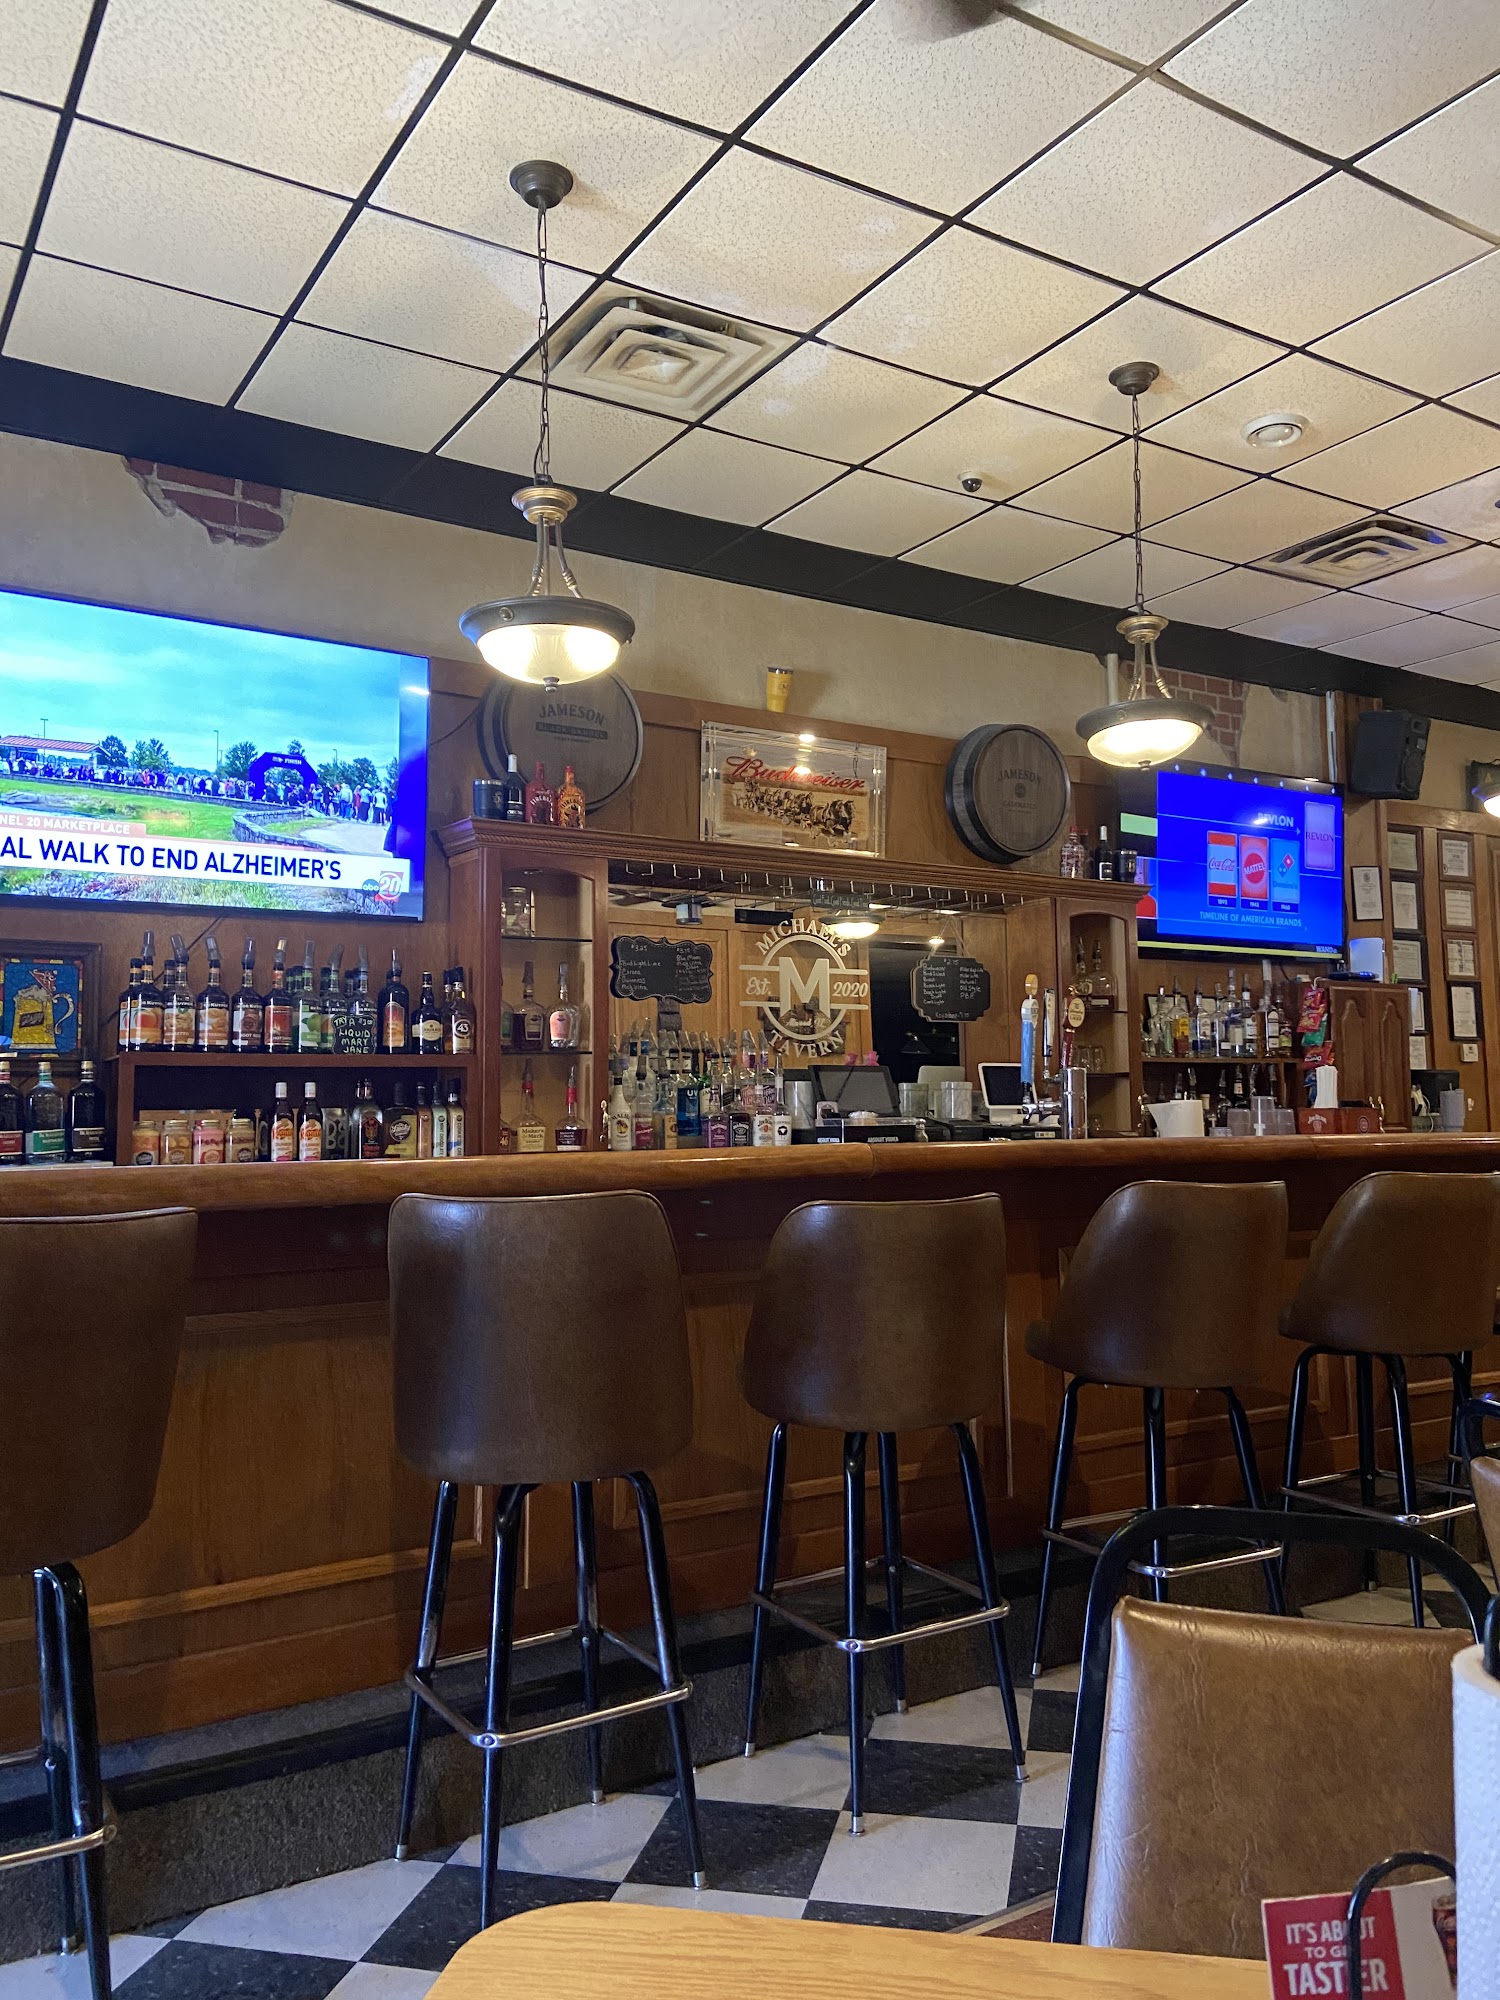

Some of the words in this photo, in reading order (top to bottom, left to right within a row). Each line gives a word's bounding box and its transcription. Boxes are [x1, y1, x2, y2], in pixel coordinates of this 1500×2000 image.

[539, 704, 605, 727] JAMESON
[726, 756, 865, 789] Budweiser
[998, 768, 1042, 785] JAMESON
[26, 816, 41, 828] 20
[43, 818, 131, 835] MARKETPLACE
[1305, 831, 1335, 842] REVLON
[0, 836, 32, 859] AL
[39, 838, 110, 865] WALK
[116, 844, 145, 867] TO
[152, 847, 198, 870] END
[204, 852, 342, 880] ALZHEIMER'S
[1243, 863, 1266, 875] MATTEL
[362, 883, 380, 892] abc
[1200, 911, 1228, 921] TIMELINE
[1230, 914, 1240, 922] OF
[1241, 915, 1275, 925] AMERICAN
[1276, 918, 1302, 927] BRANDS
[755, 918, 851, 957] MICHAEL'S
[745, 976, 771, 996] Est.
[832, 981, 869, 998] 2020
[778, 956, 831, 1019] M
[334, 1016, 347, 1027] TRY
[349, 1018, 356, 1026] A
[457, 1022, 469, 1033] 43
[338, 1028, 371, 1038] LIQUID
[341, 1038, 368, 1046] MARY
[343, 1046, 369, 1054] JANE
[769, 1030, 844, 1059] TAVERN
[686, 1089, 699, 1097] UV
[1286, 1922, 1318, 1945] IT'S
[1321, 1916, 1376, 1942] ABUT
[1304, 1946, 1327, 1959] TO
[1283, 1958, 1389, 1996] TASTER
